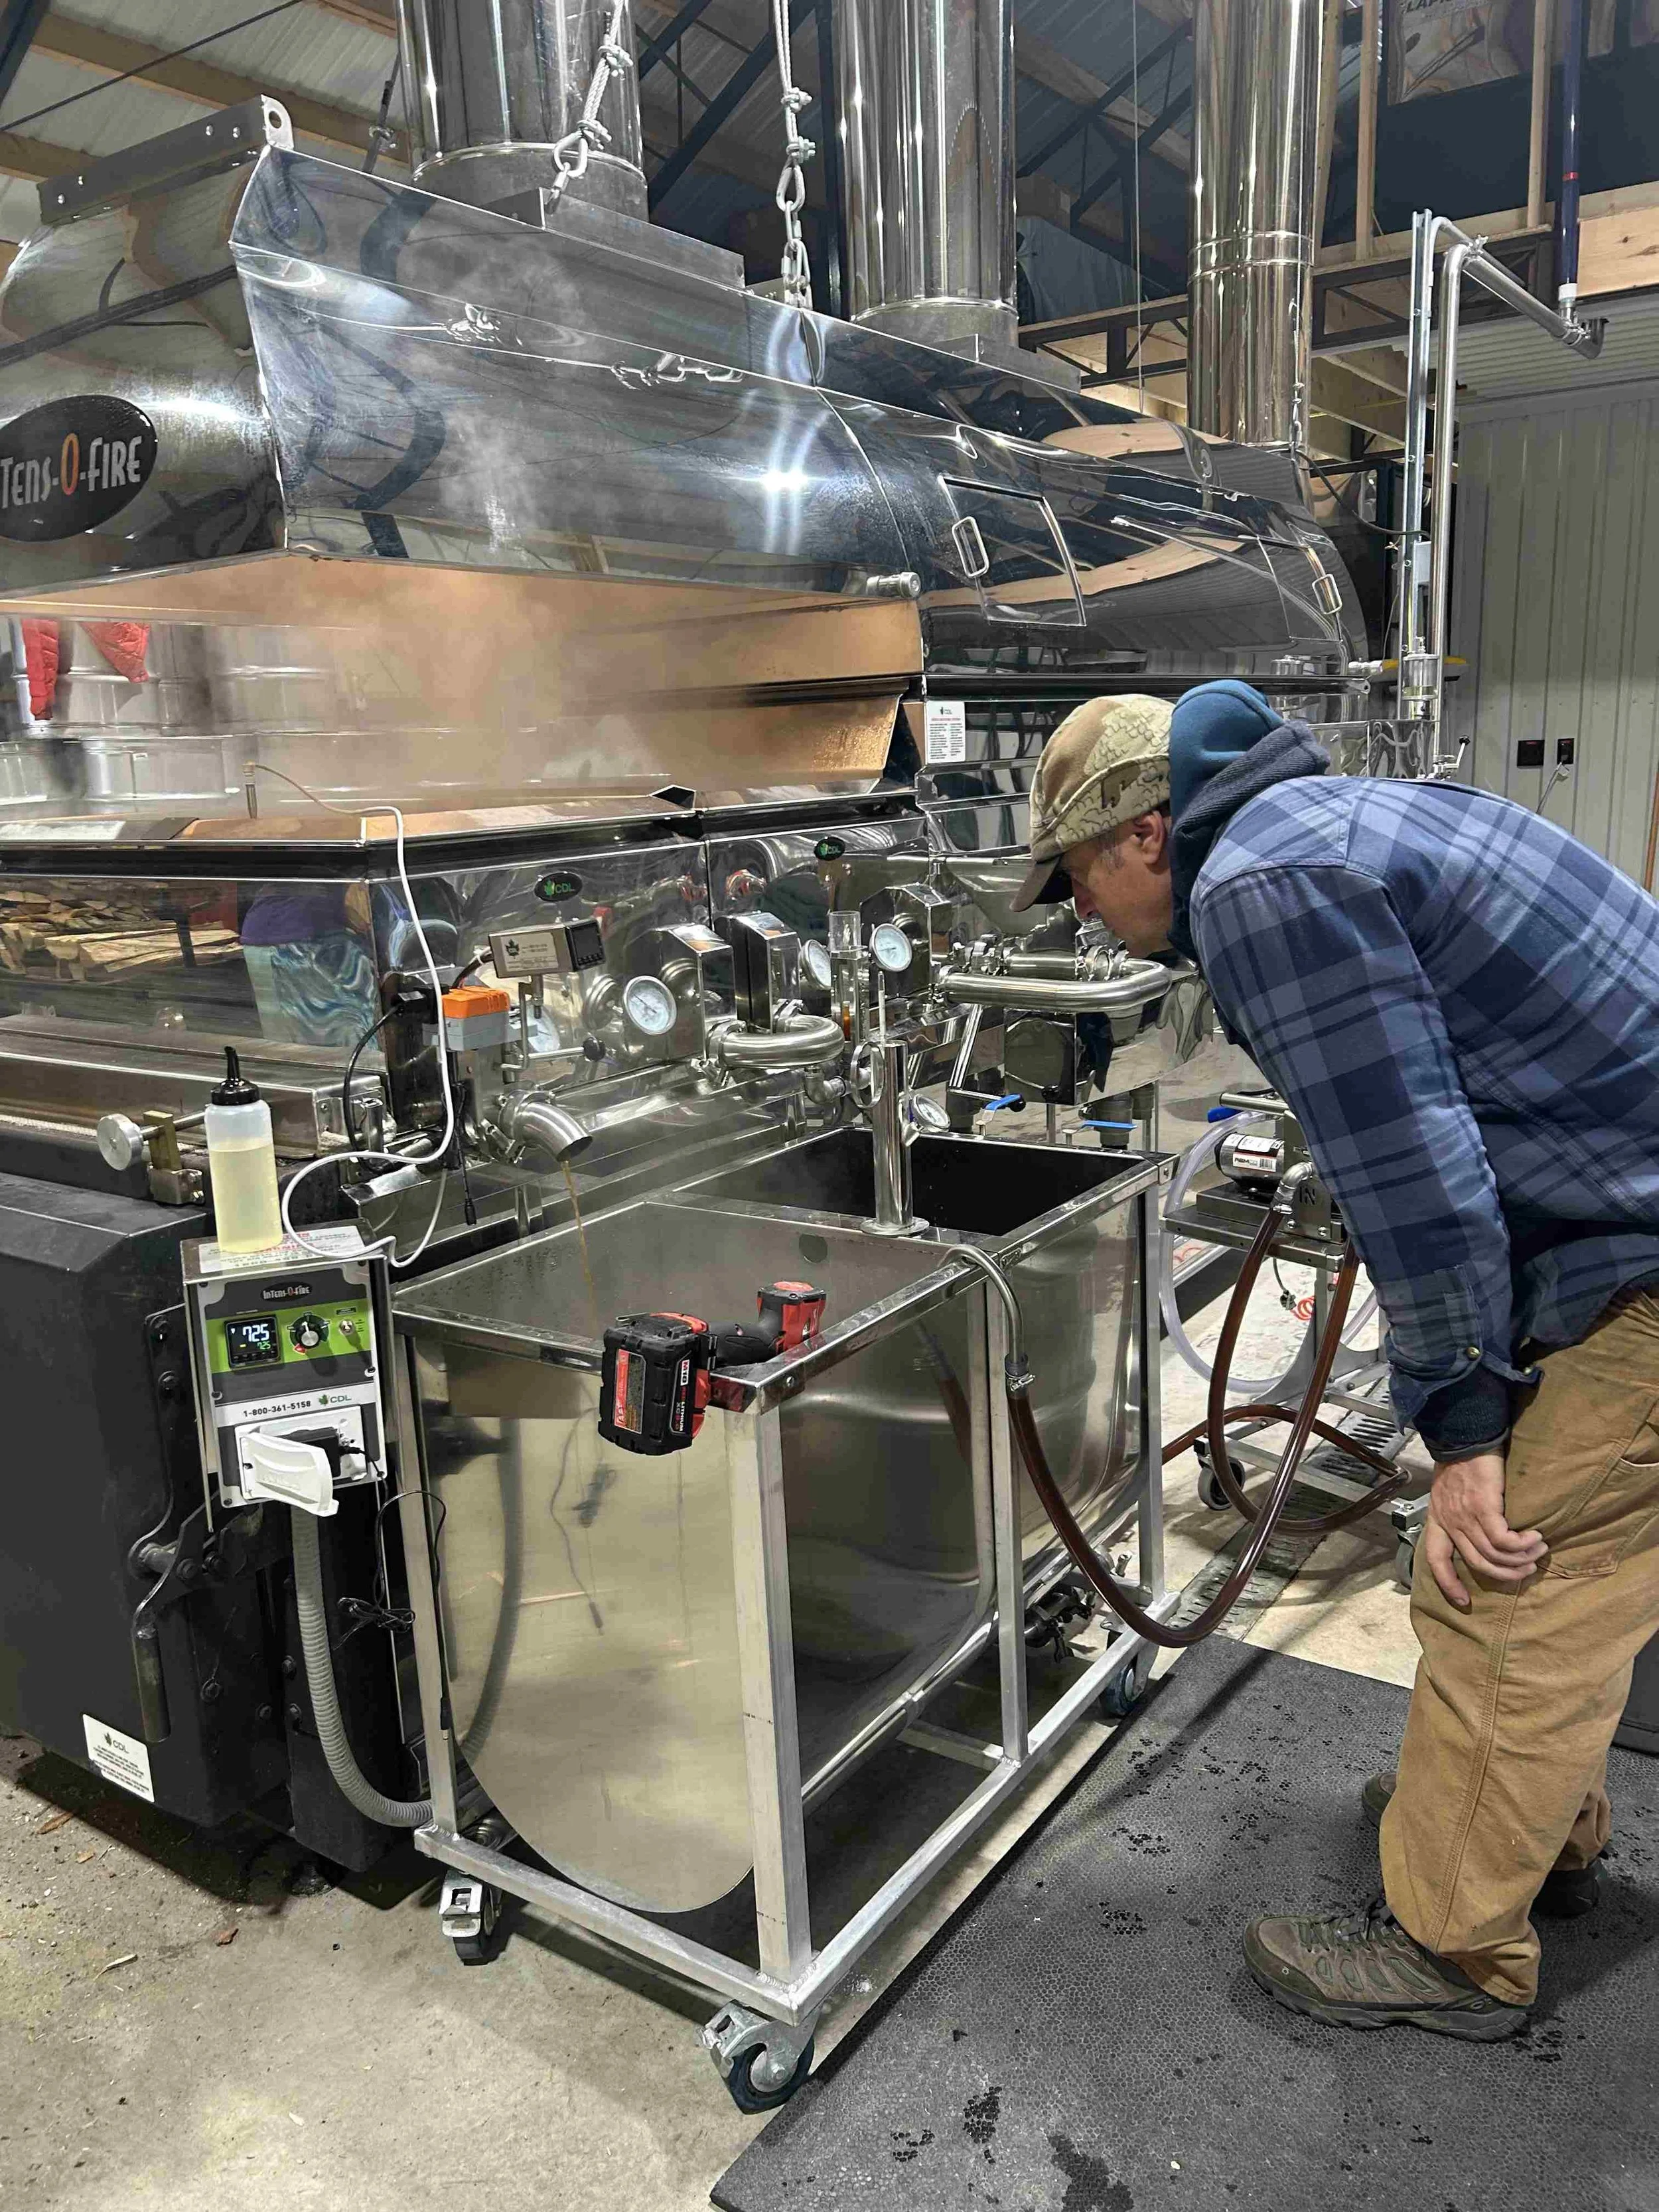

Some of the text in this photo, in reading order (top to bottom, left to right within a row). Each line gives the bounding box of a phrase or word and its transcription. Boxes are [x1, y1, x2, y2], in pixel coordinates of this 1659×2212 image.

[242, 1323, 270, 1343] 725
[330, 1395, 352, 1404] CDL
[243, 1400, 311, 1418] 1-800-361-5158
